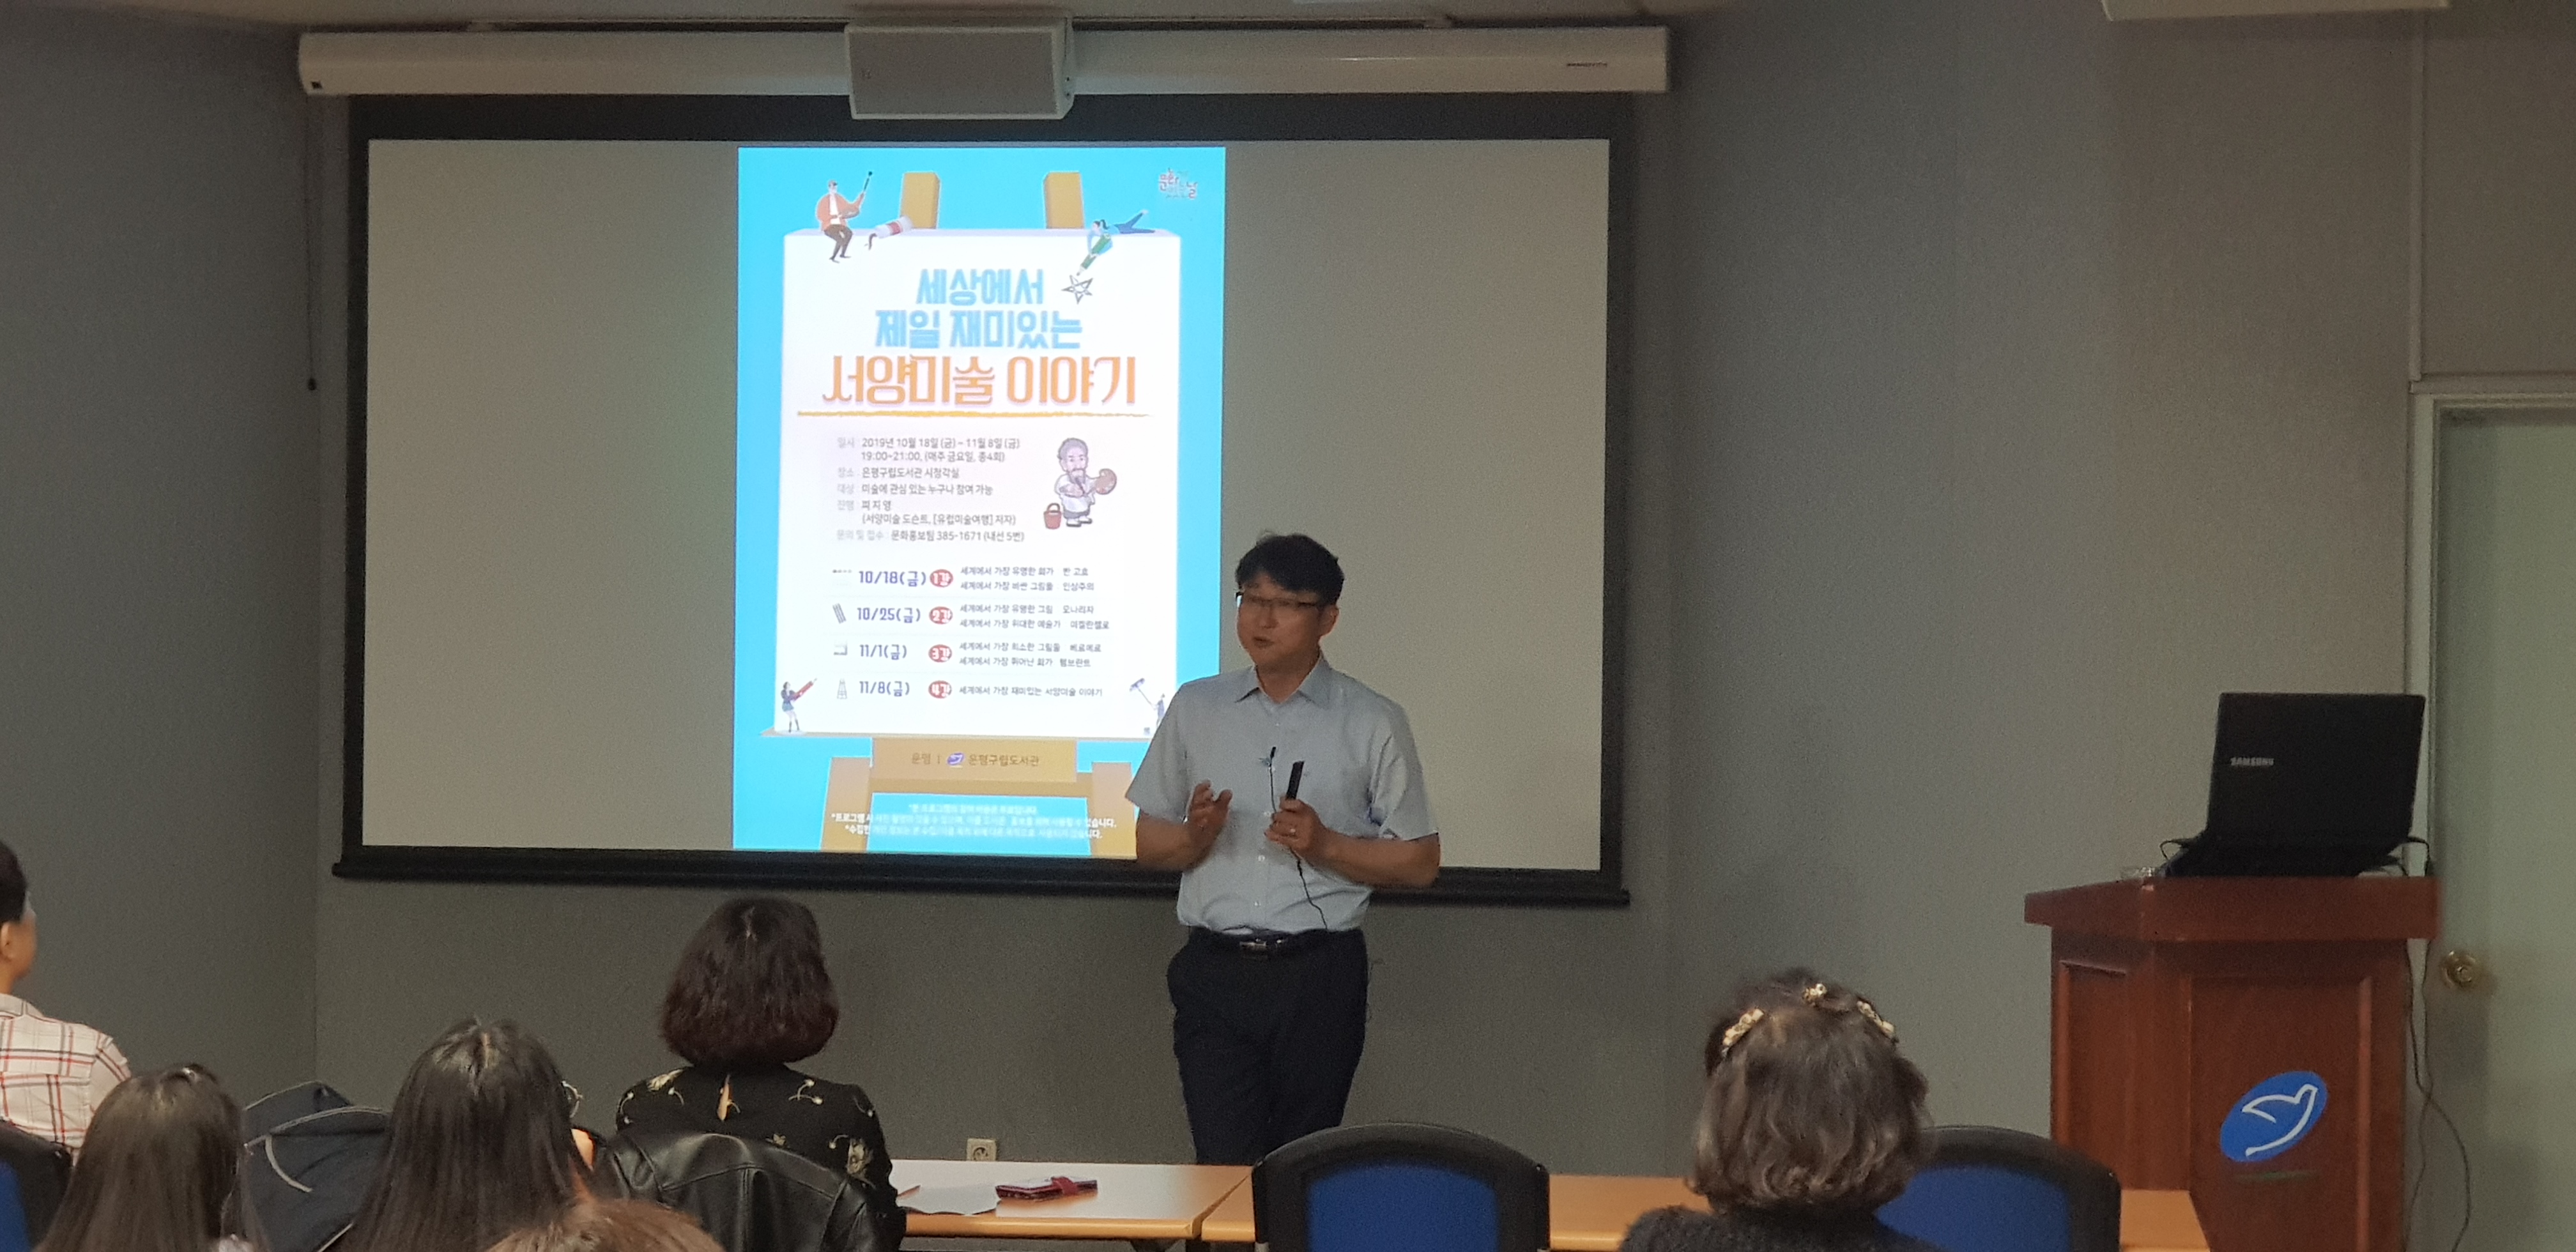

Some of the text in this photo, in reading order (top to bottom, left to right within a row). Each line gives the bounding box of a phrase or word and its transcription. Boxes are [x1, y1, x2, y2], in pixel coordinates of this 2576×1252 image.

[915, 268, 1045, 305] 세상에서
[875, 310, 1082, 349] 제일 재미있는
[822, 355, 1135, 405] 서양미술 이야기
[862, 438, 894, 448] 2019년
[896, 438, 916, 448] 10월
[919, 438, 938, 448] 18일
[940, 438, 956, 448] (금)
[966, 438, 986, 448] 11월
[924, 451, 945, 462] (매주
[861, 468, 923, 478] 은평구립도서관
[924, 468, 959, 478] 시청각실
[861, 484, 887, 494] 미술에
[890, 484, 907, 494] 관심
[908, 484, 926, 494] 있는
[928, 484, 954, 494] 누구나
[956, 484, 974, 494] 참여
[976, 484, 993, 494] 가능
[862, 514, 901, 524] (서양미술
[933, 514, 993, 524] [유럽미술여행]
[995, 514, 1016, 524] 저자)
[891, 530, 935, 540] 문화홍보팀
[937, 530, 981, 540] 385-1671
[983, 530, 1004, 540] (내선
[1006, 530, 1025, 540] 5번)
[960, 567, 992, 576] 세계에서
[994, 567, 1010, 576] 가장
[1012, 567, 1036, 576] 유명한
[1038, 567, 1054, 576] 화가
[960, 582, 992, 591] 세계에서
[994, 582, 1009, 591] 가장
[1030, 582, 1054, 591] 그림들
[1063, 582, 1094, 592] 인상주의
[960, 604, 1094, 614] 세계에서 가장 유명한 그림 모나리자
[960, 619, 991, 629] 세계에서
[993, 619, 1009, 629] 가장
[1012, 619, 1035, 629] 위대한
[1037, 619, 1061, 629] 예술가
[959, 642, 990, 652] 세계에서
[993, 642, 1009, 652] 가장
[1038, 642, 1061, 652] 그림들
[959, 657, 990, 666] 세계에서
[993, 657, 1008, 666] 가장
[1011, 657, 1034, 666] 뛰어난
[1037, 657, 1053, 666] 화가
[959, 686, 1103, 697] 세계에서 가장 재미있는 서양미술 이야기
[969, 754, 1039, 767] 은평구립도서관
